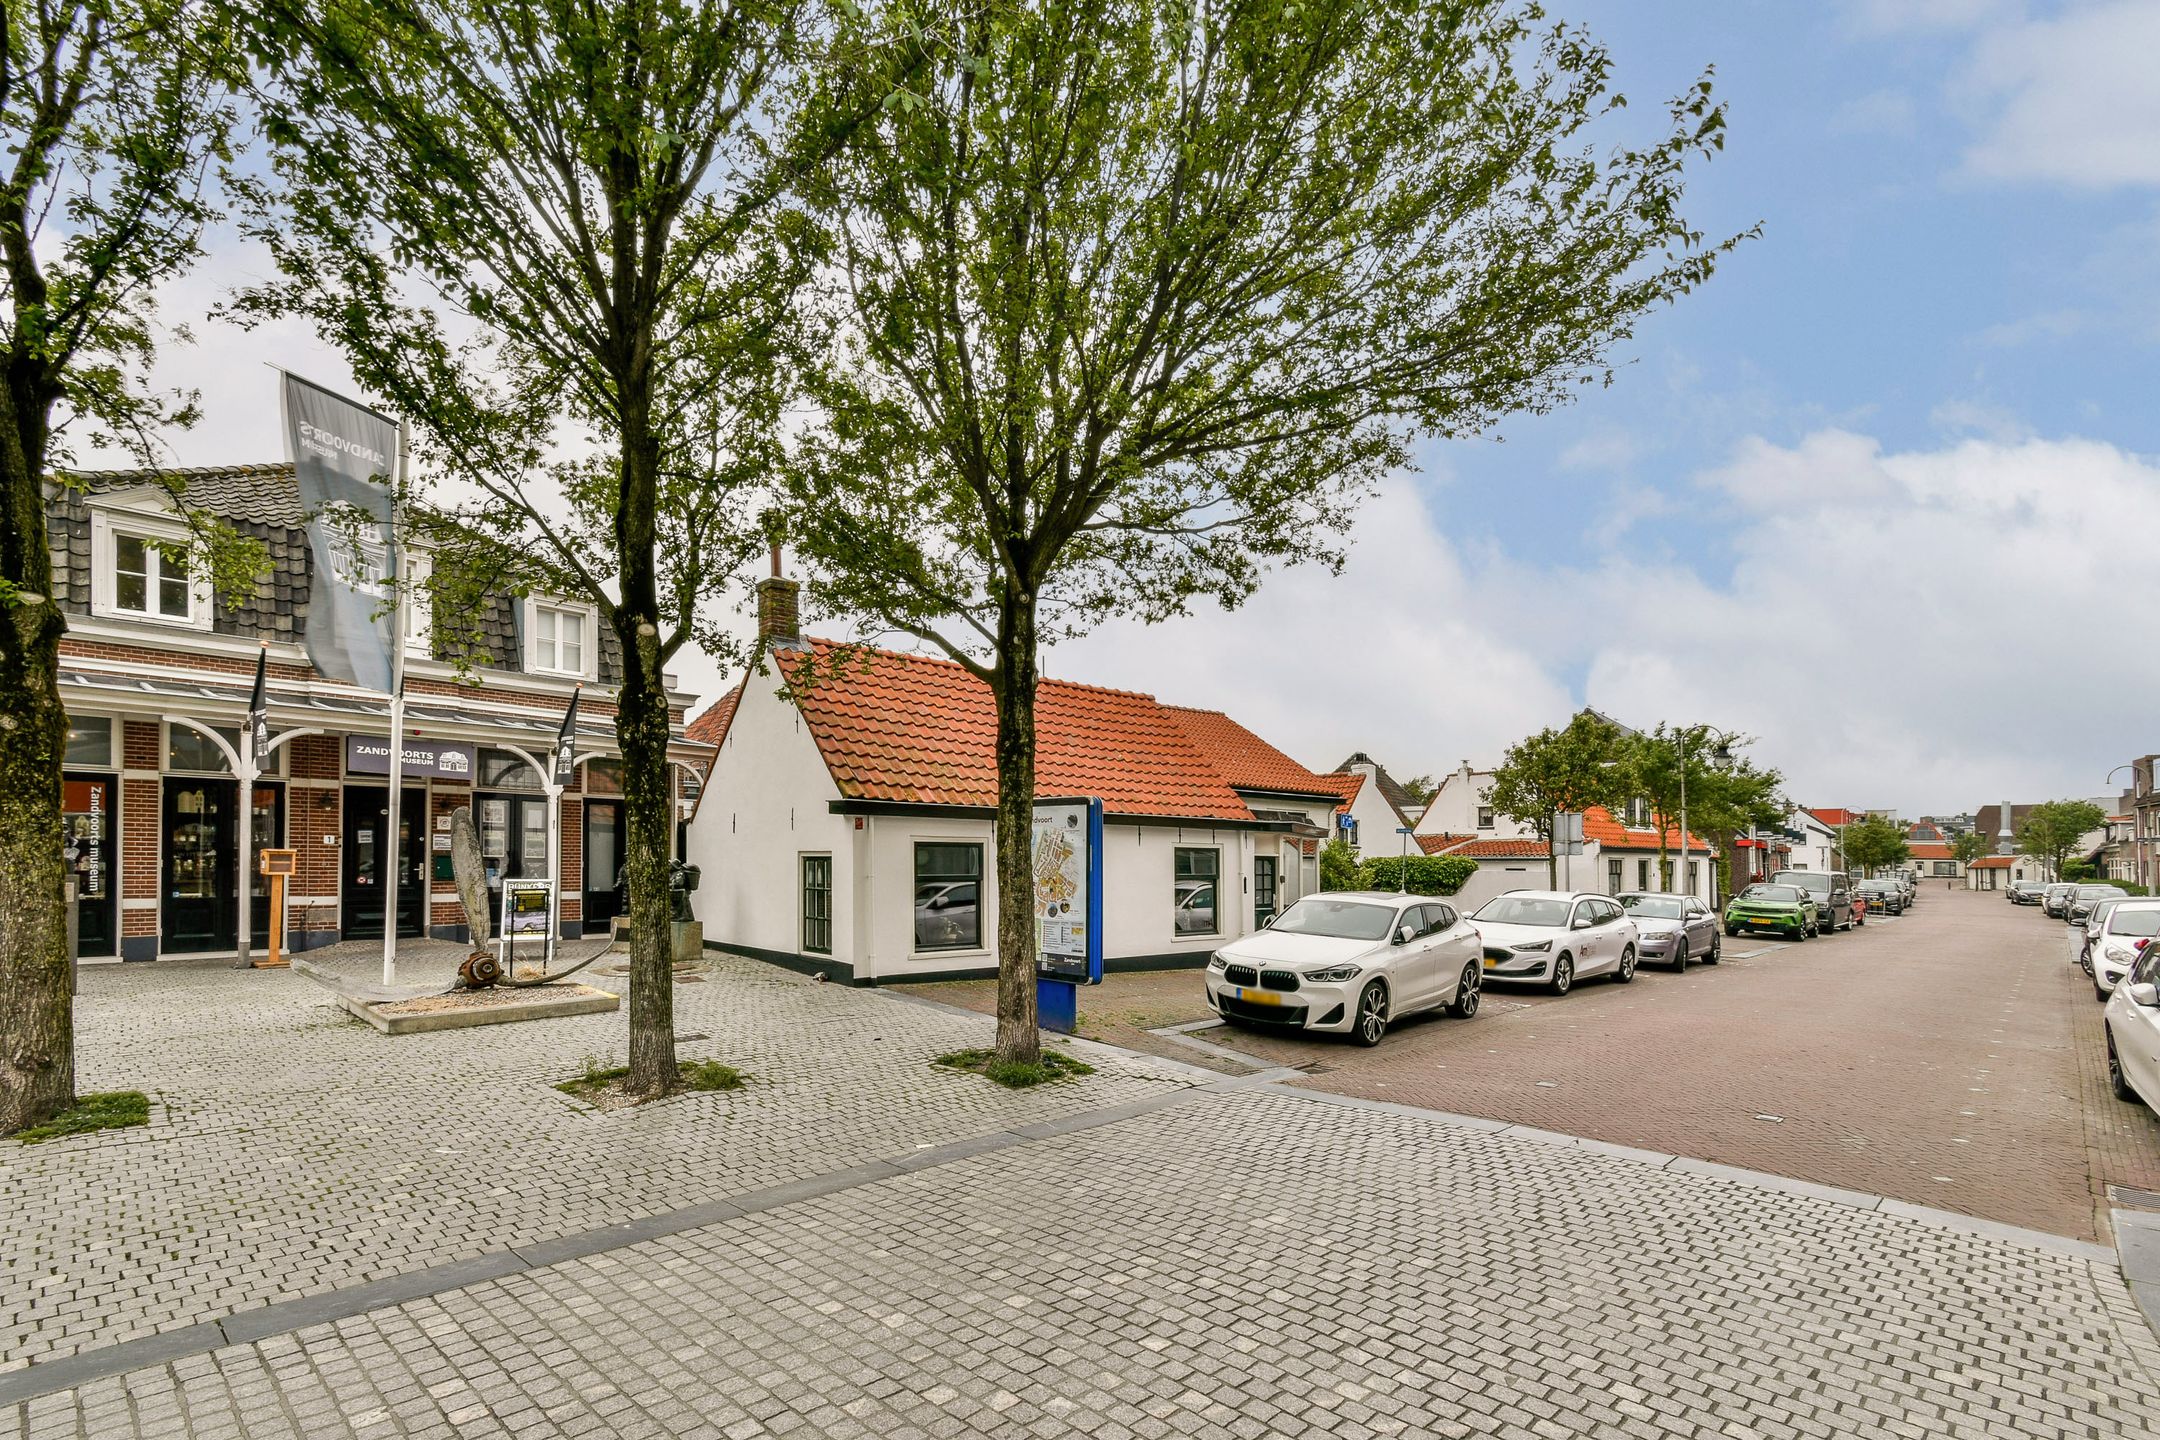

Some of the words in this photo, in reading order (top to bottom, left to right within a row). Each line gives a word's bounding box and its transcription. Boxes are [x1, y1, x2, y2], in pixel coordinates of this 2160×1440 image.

[356, 745, 434, 760] ZANDOORTS
[400, 757, 434, 766] MUSEUM
[90, 786, 102, 846] Zandvoorts
[89, 847, 99, 892] museum
